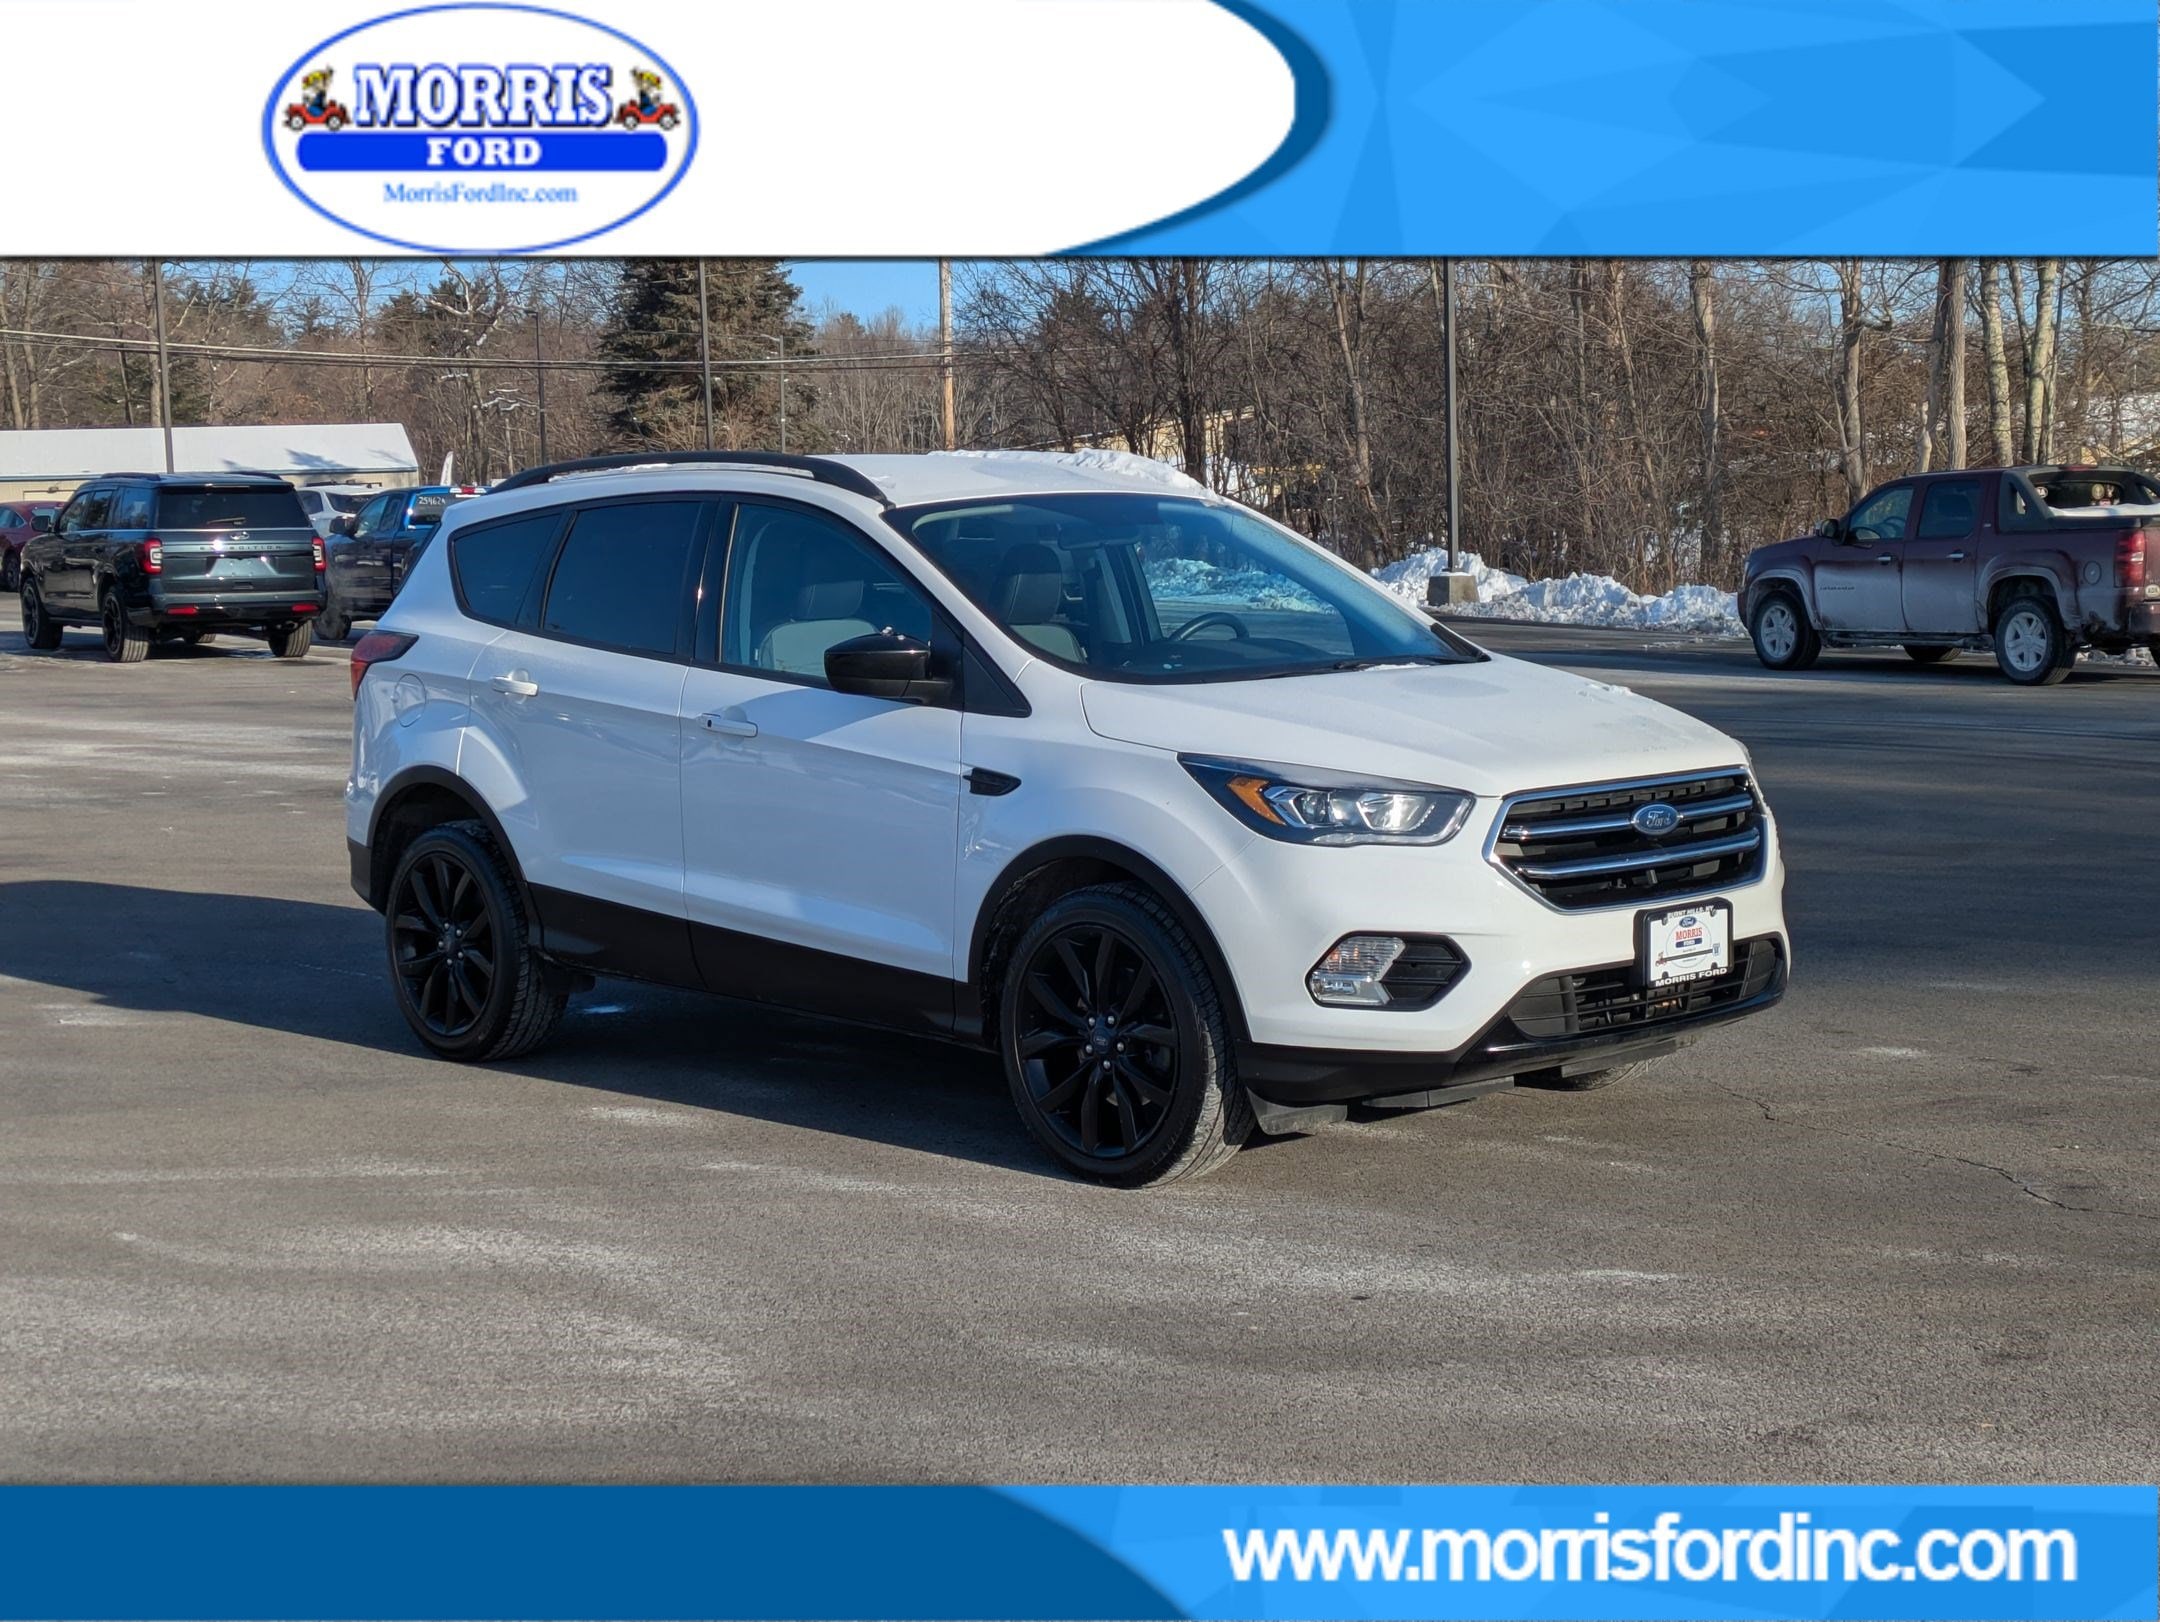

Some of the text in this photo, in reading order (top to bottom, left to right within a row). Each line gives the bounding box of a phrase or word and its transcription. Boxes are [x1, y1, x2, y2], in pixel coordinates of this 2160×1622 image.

[1646, 810, 1672, 828] Ford
[1676, 928, 1702, 940] MORRIS
[1656, 968, 1727, 987] MORRIS FORD
